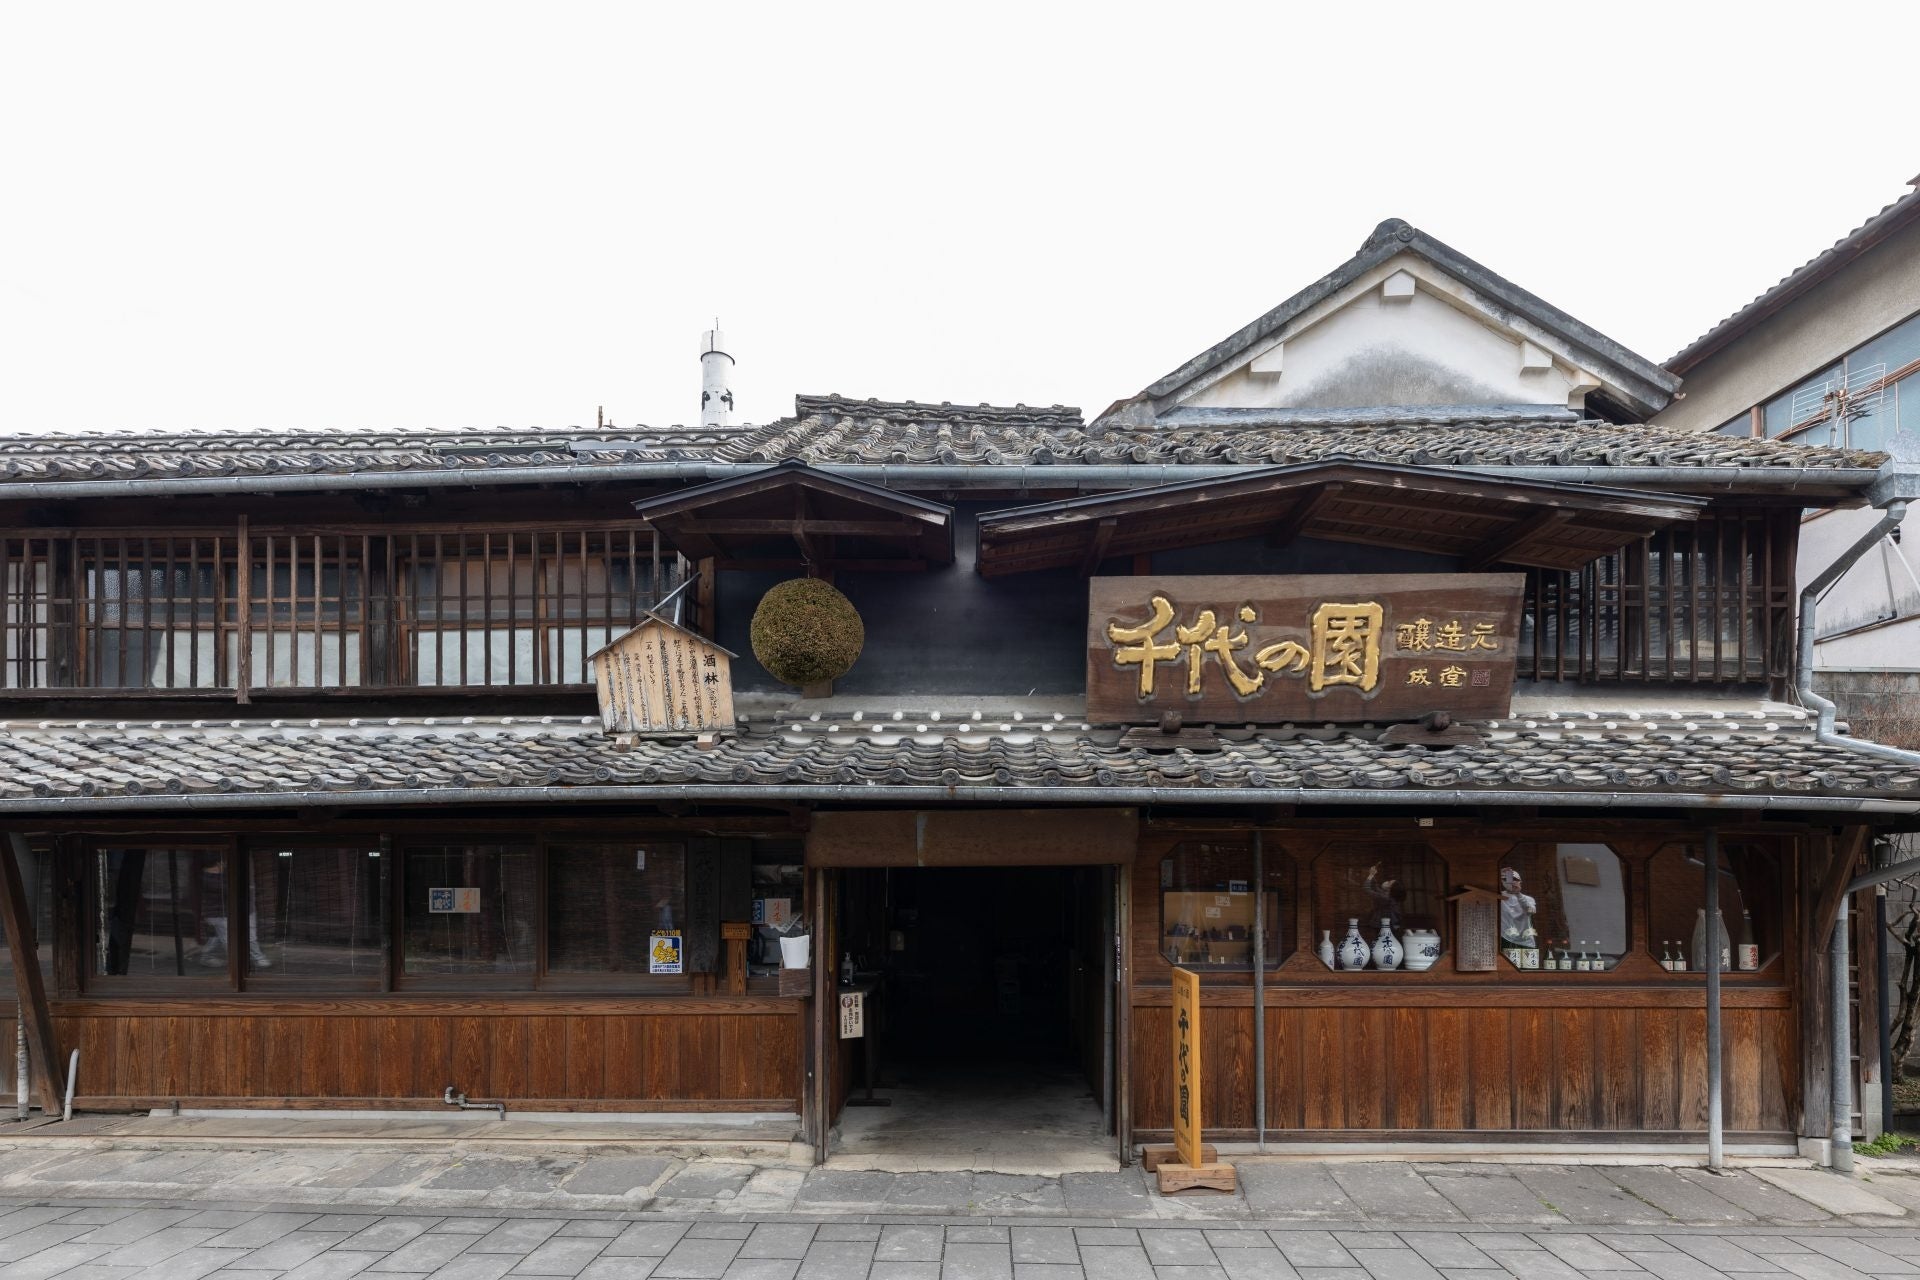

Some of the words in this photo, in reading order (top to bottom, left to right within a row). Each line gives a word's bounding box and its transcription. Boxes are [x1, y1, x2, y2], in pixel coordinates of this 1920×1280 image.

[1108, 597, 1383, 697] 千代の園
[1178, 1007, 1189, 1128] 千代の園
